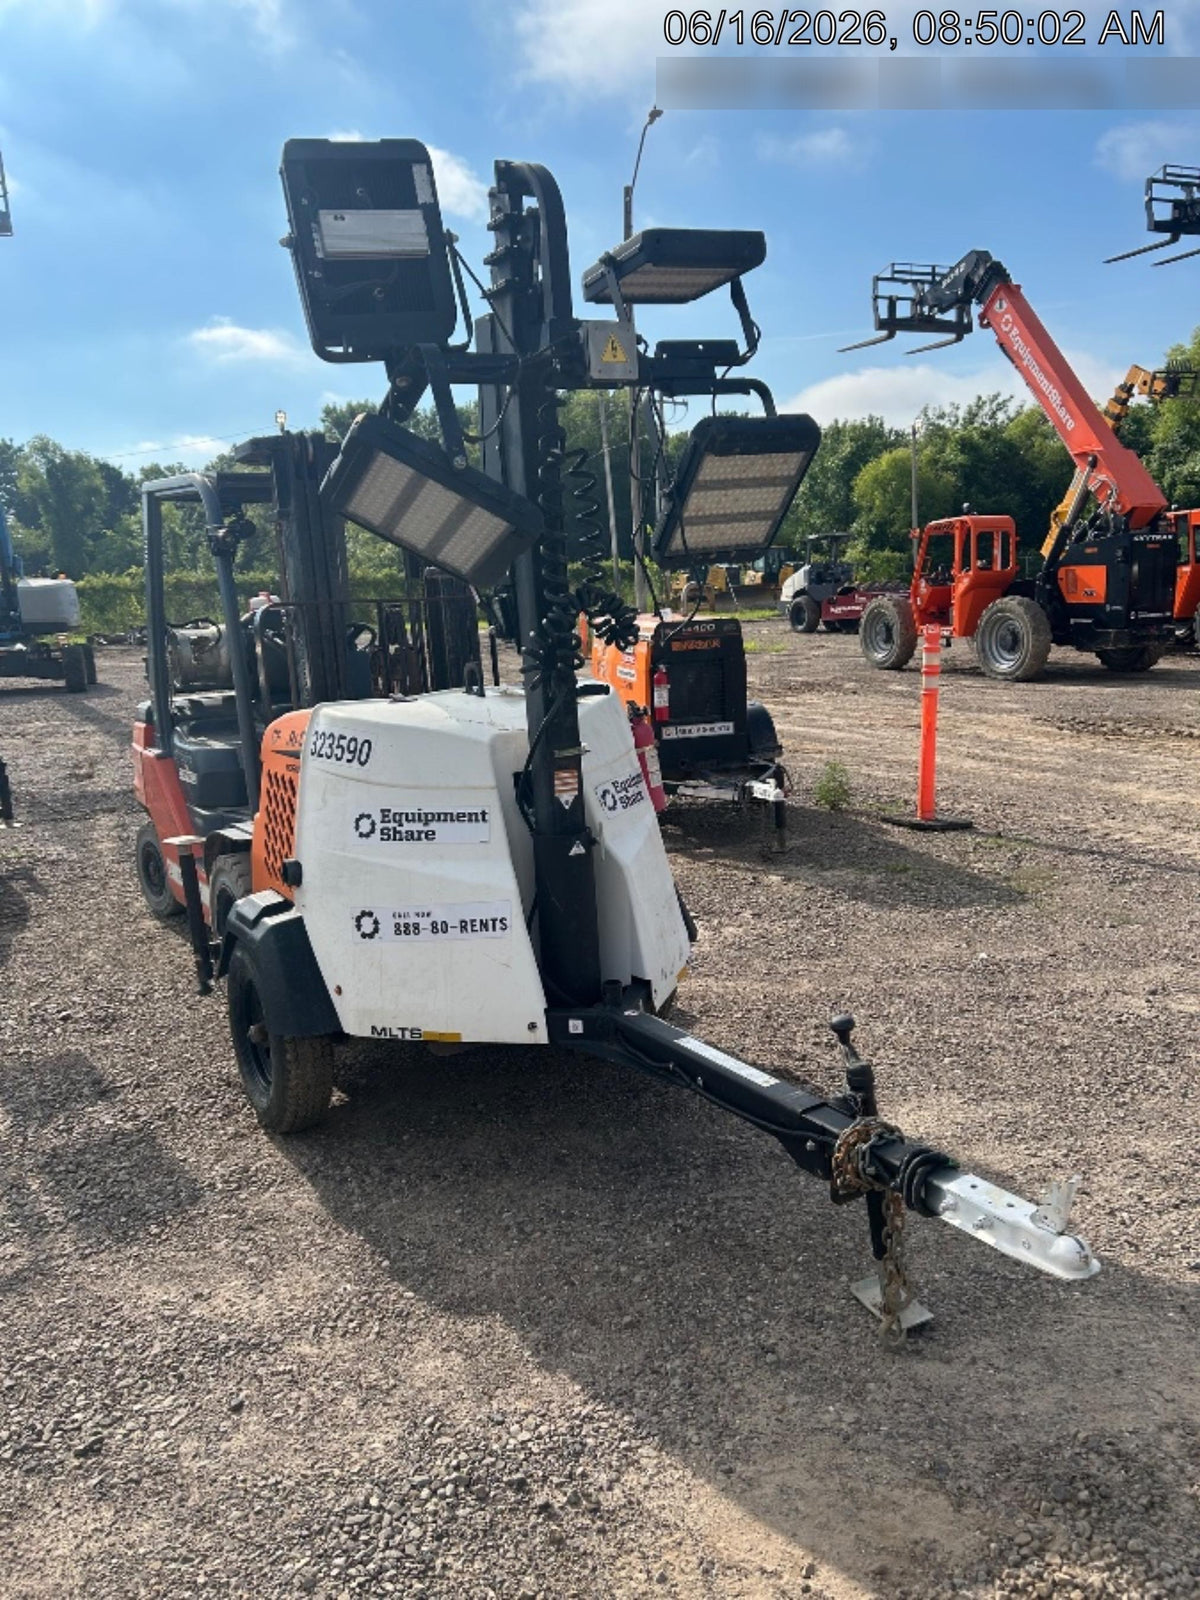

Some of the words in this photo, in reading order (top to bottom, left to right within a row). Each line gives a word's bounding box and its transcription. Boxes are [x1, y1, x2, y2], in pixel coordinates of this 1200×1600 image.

[310, 730, 373, 767] 323590
[379, 808, 489, 827] Equipment
[379, 826, 437, 842] Share
[393, 917, 509, 936] 888-80-RENTS
